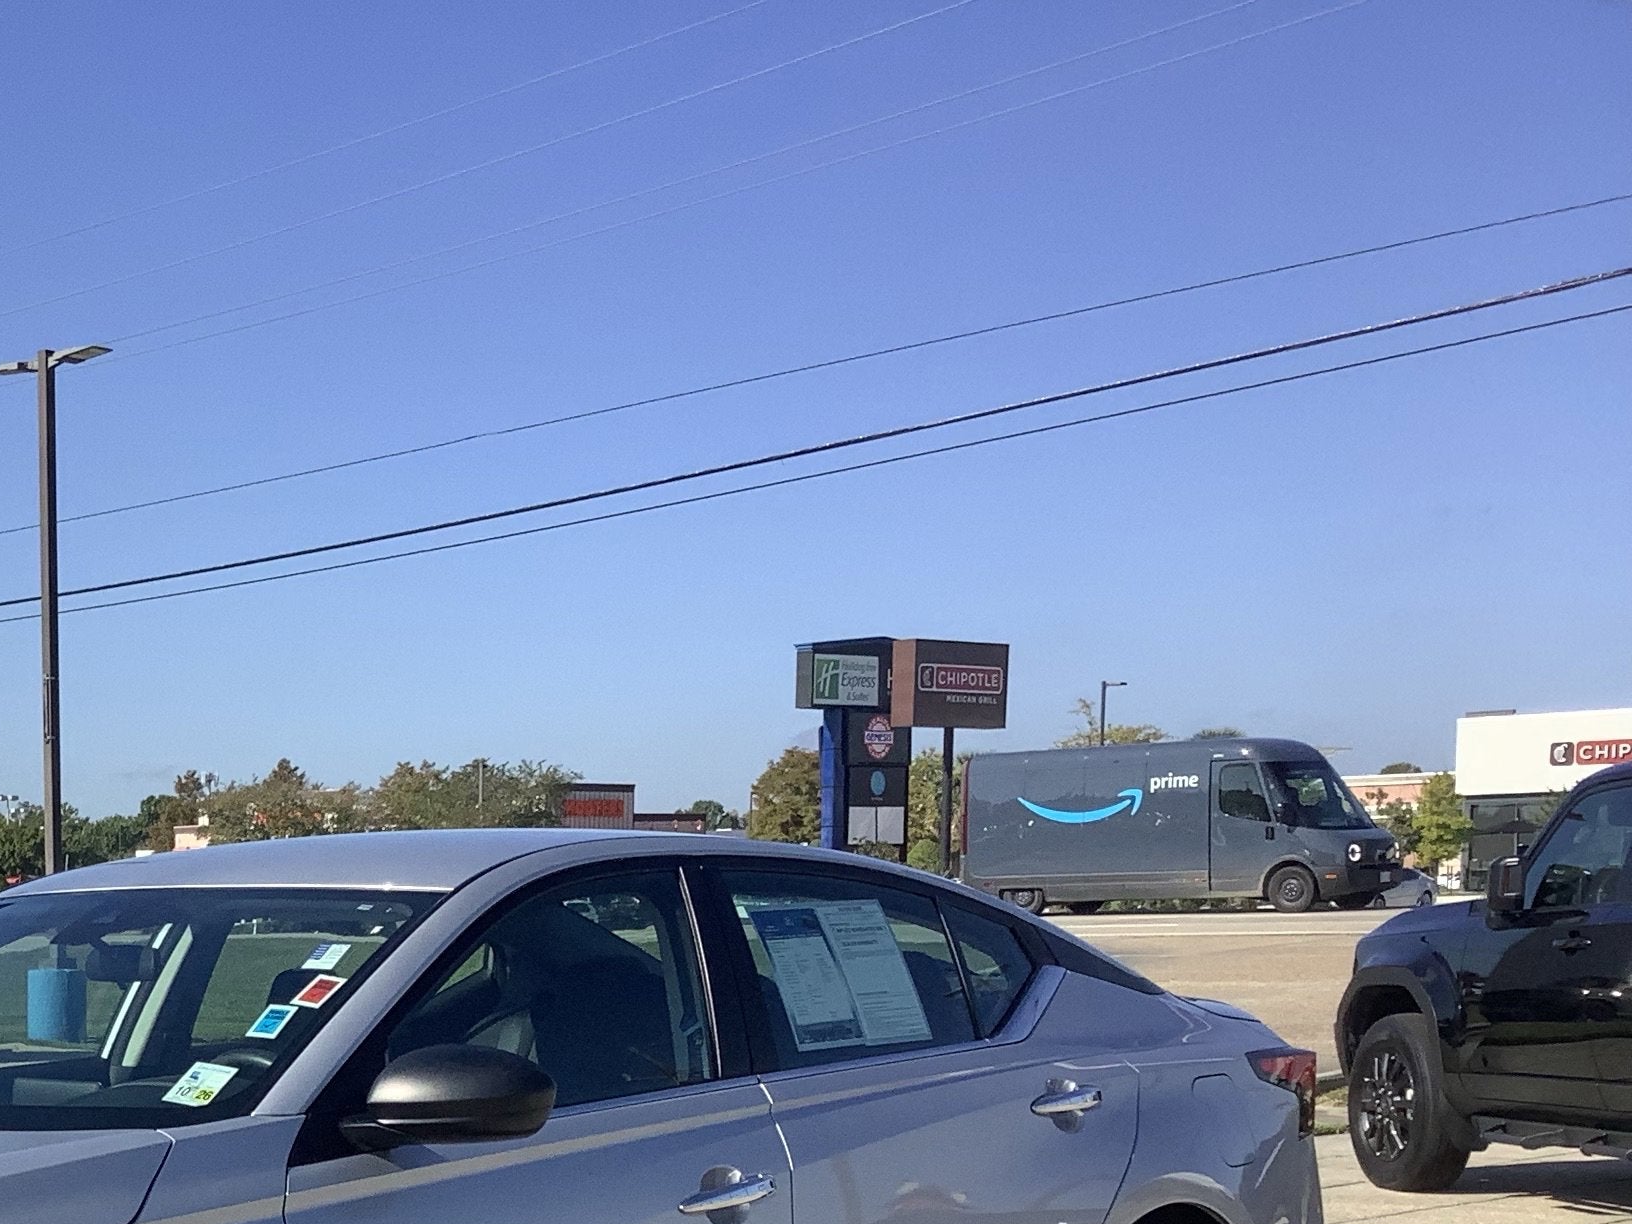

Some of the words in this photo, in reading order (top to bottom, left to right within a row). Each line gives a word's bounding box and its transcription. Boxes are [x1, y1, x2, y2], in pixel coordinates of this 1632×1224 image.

[841, 672, 876, 691] Express
[937, 671, 999, 687] CHIPOTLE
[1150, 771, 1199, 793] prime
[175, 1086, 192, 1096] 10
[195, 1089, 214, 1101] 26
